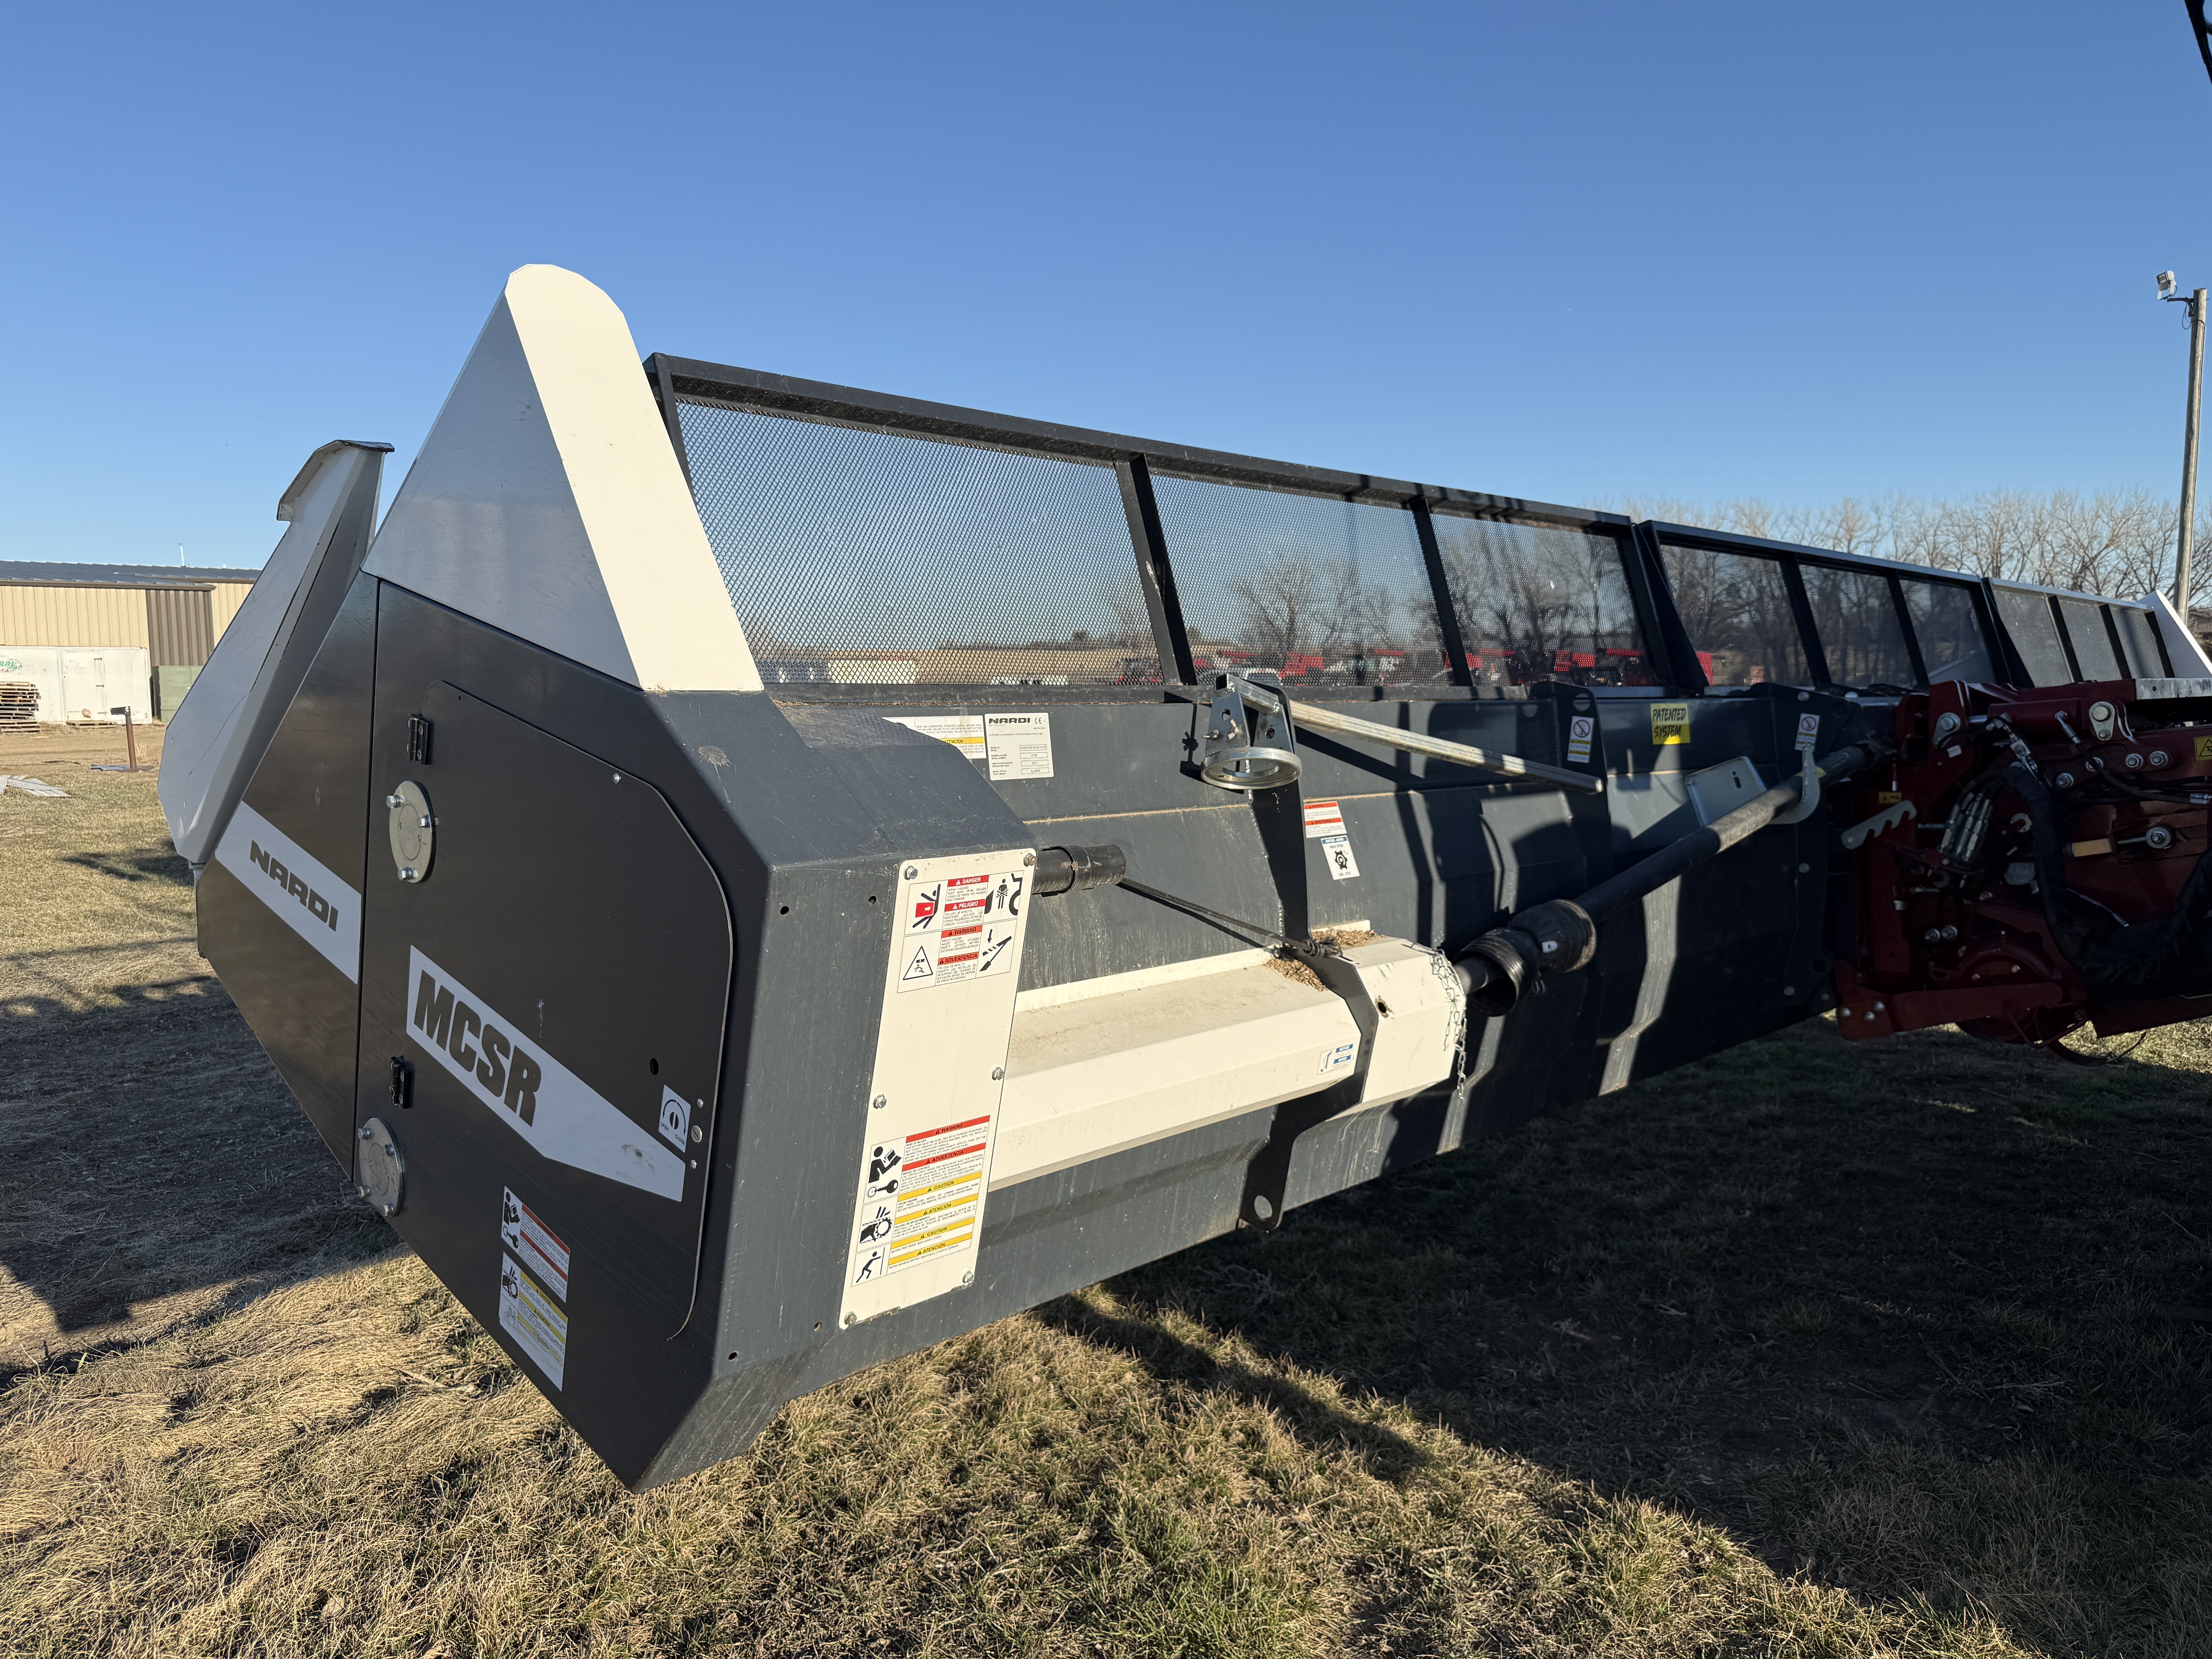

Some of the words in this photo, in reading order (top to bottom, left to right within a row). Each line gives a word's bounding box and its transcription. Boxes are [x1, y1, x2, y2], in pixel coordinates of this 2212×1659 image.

[1652, 708, 1686, 722] PATENTED
[1654, 725, 1681, 739] SYSTEM
[250, 840, 338, 932] NARDI
[945, 953, 977, 963] ADVERTENCIA
[414, 969, 542, 1127] MCSR
[660, 1122, 669, 1132] OPEN
[941, 1123, 963, 1133] WARNING
[675, 1134, 685, 1145] CLOSE
[932, 1149, 963, 1162] ADVERTENCIA
[934, 1180, 954, 1190] CAUTION
[927, 1226, 947, 1237] CAUTION
